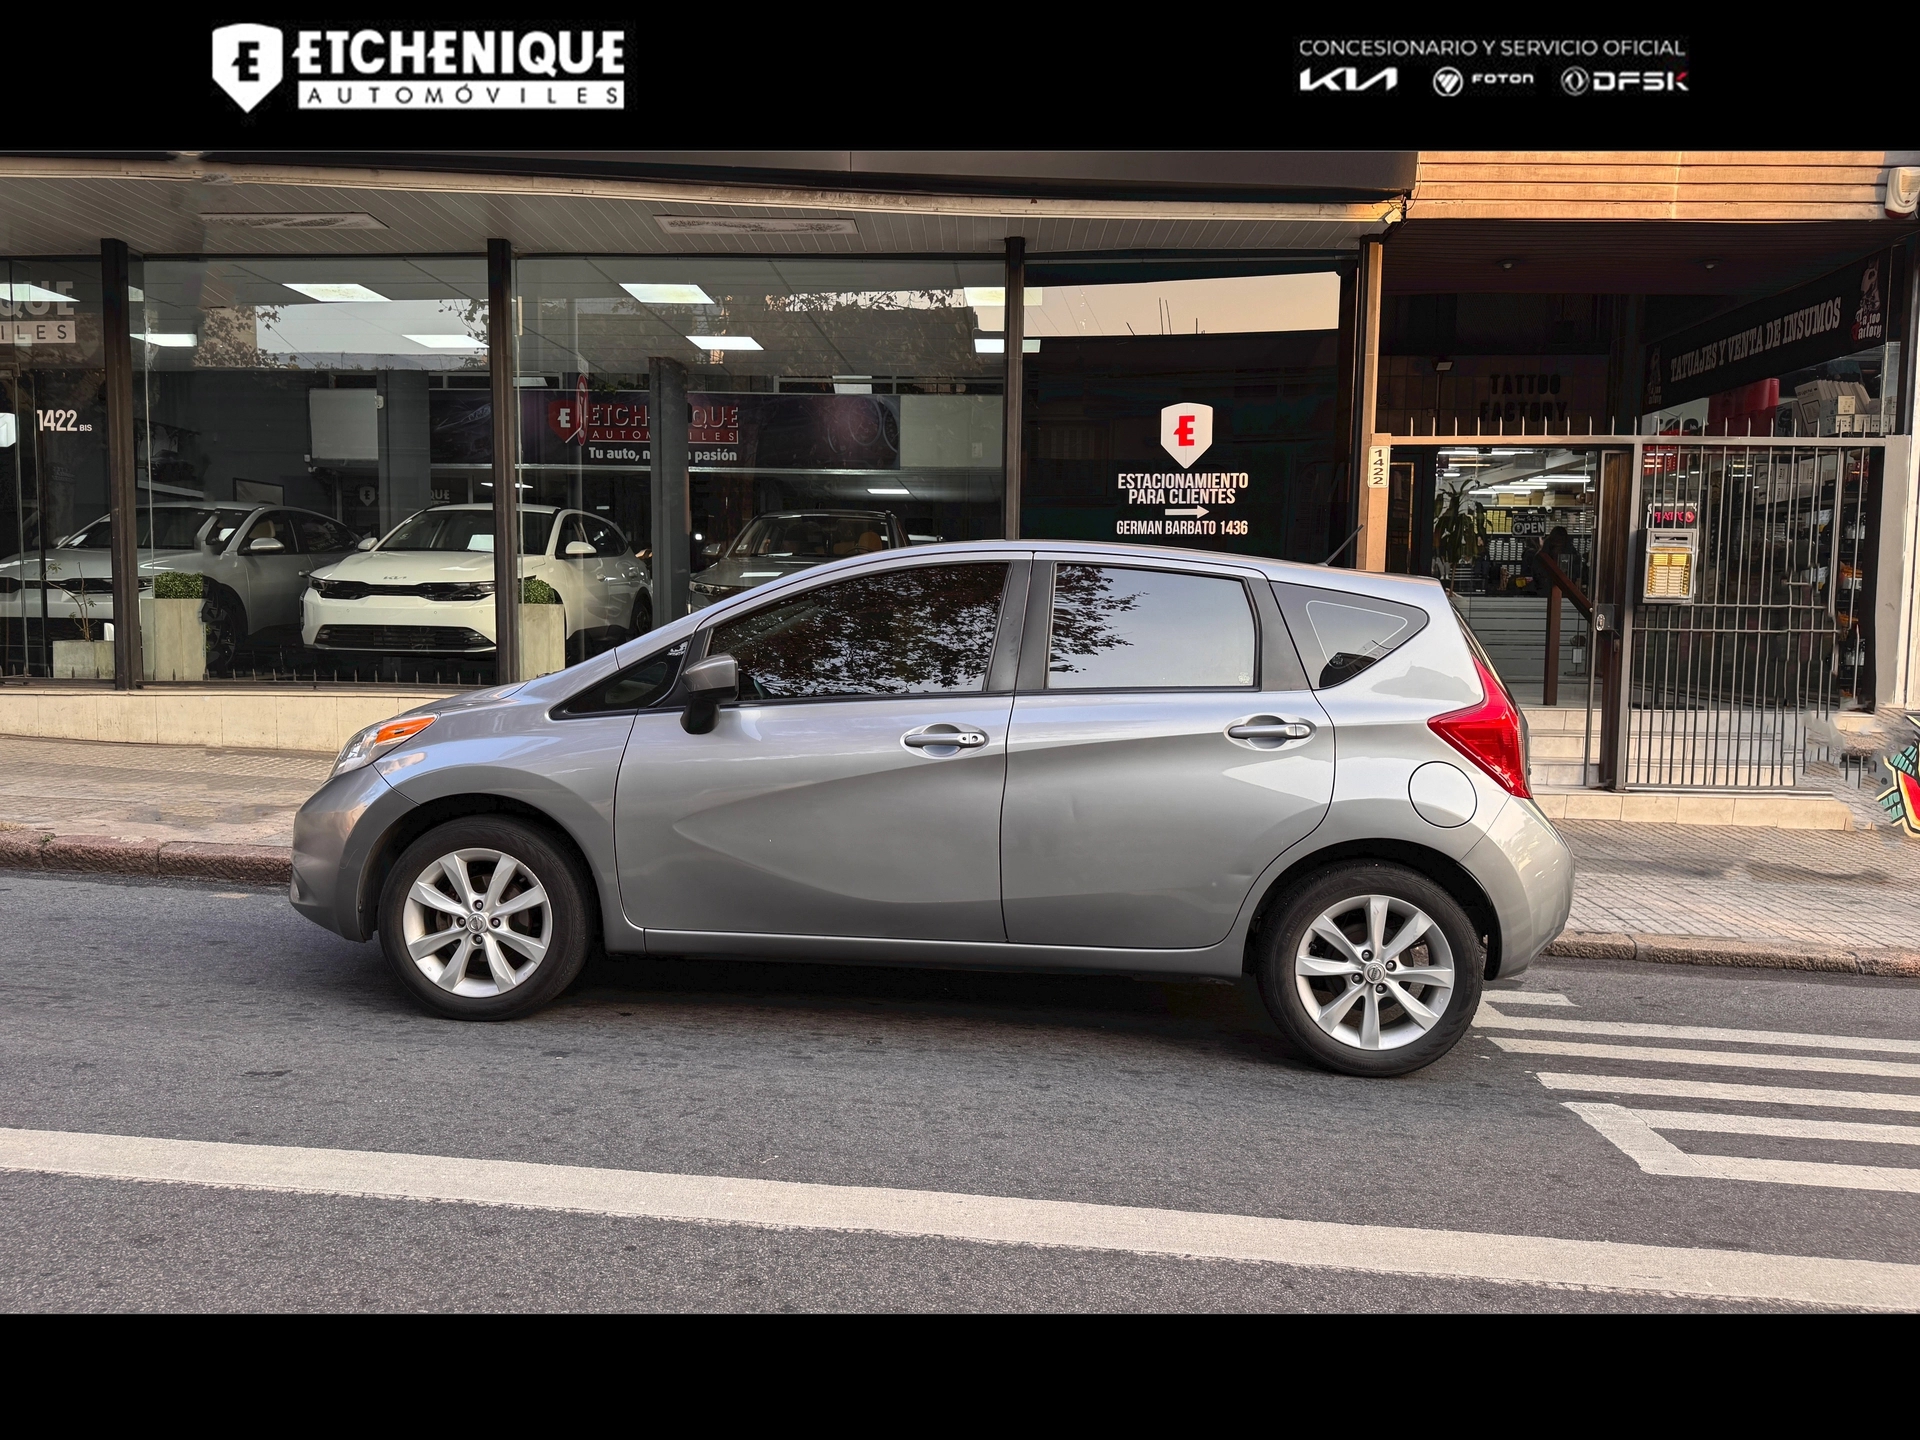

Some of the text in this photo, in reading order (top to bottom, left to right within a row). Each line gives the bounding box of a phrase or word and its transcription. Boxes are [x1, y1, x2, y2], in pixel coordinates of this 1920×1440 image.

[1670, 296, 1842, 383] TATUAJES Y VENTA DE INSUMOS
[1490, 373, 1561, 395] TATTOO
[37, 409, 93, 432] 1422 BIS
[1479, 401, 1568, 423] FACTORY
[589, 447, 604, 460] Tu
[606, 448, 640, 462] auto,
[694, 449, 738, 464] pasión
[1373, 449, 1385, 485] 1422
[1117, 472, 1249, 489] ESTACIONAMIENTO
[1128, 488, 1236, 505] PARA CLIENTES
[1116, 520, 1249, 535] GERMAN BARBATO 1436
[1512, 522, 1545, 535] OPEN
